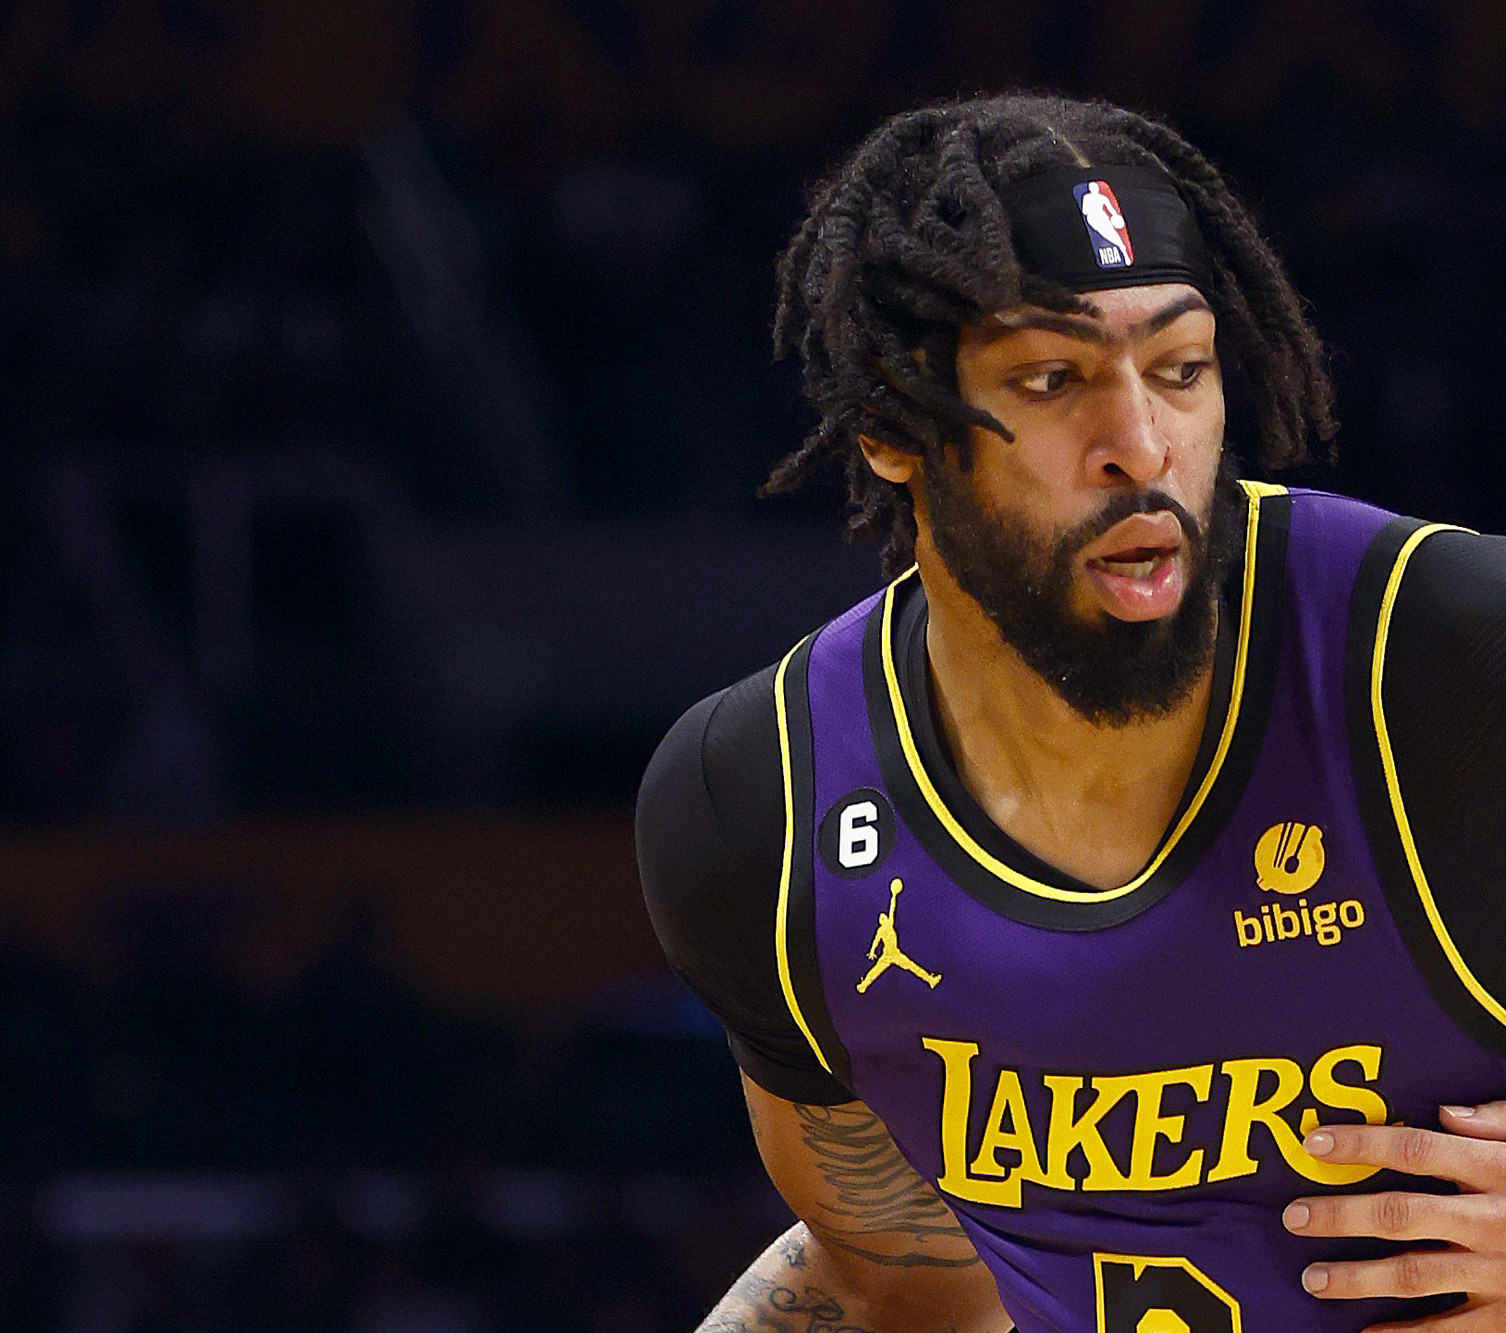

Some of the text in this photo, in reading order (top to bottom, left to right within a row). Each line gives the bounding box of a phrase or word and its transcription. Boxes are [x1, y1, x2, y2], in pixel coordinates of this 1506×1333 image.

[1099, 247, 1121, 265] NBA
[838, 801, 879, 868] 6
[1233, 898, 1366, 948] bibigo
[921, 1036, 1388, 1208] LAKERS
